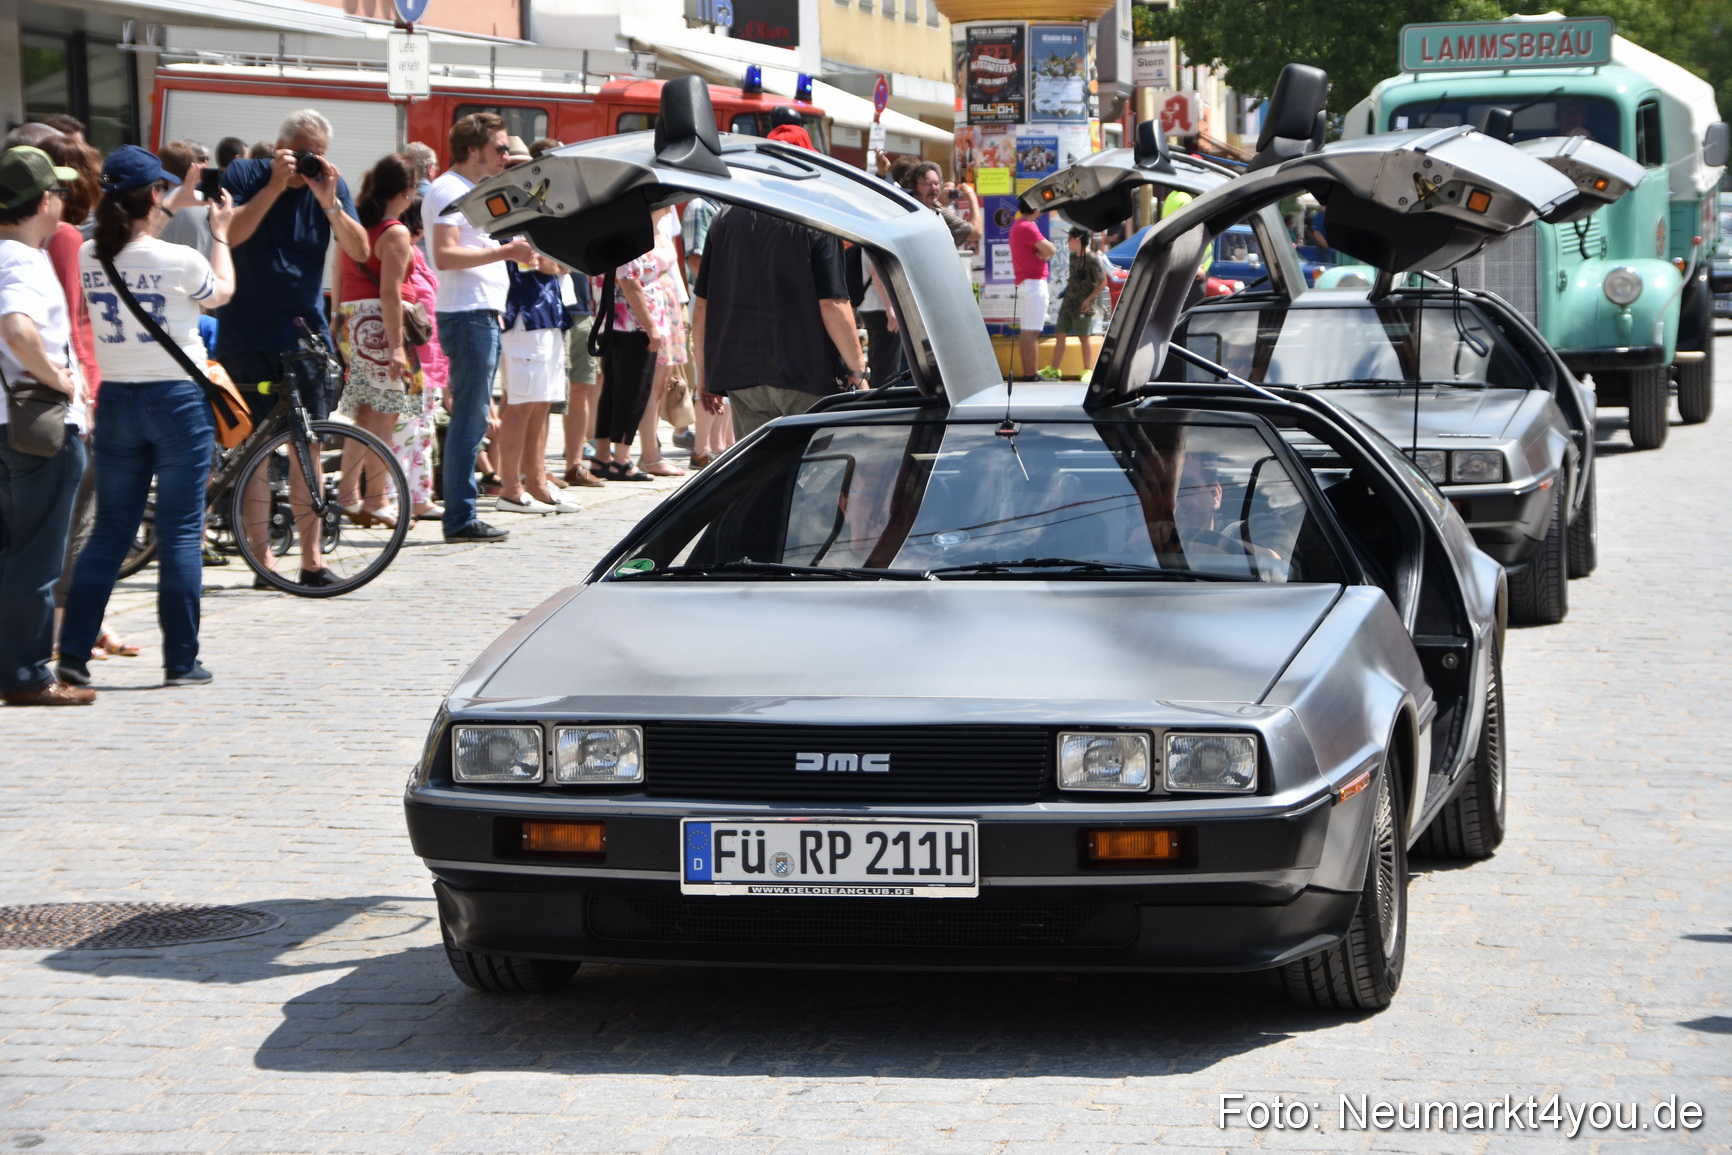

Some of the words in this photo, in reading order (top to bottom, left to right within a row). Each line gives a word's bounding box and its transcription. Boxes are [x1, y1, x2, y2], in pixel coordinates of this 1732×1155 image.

[1421, 26, 1593, 62] LAMMSBRÄU
[971, 61, 1017, 73] ALTSTADTFEST
[1137, 58, 1164, 67] Stern
[83, 271, 161, 289] RELAY
[714, 829, 765, 874] FÜ
[800, 830, 851, 875] RP
[866, 831, 969, 876] 211H
[693, 857, 703, 870] D
[751, 886, 911, 895] WWW.DELOREANCLUB.DE
